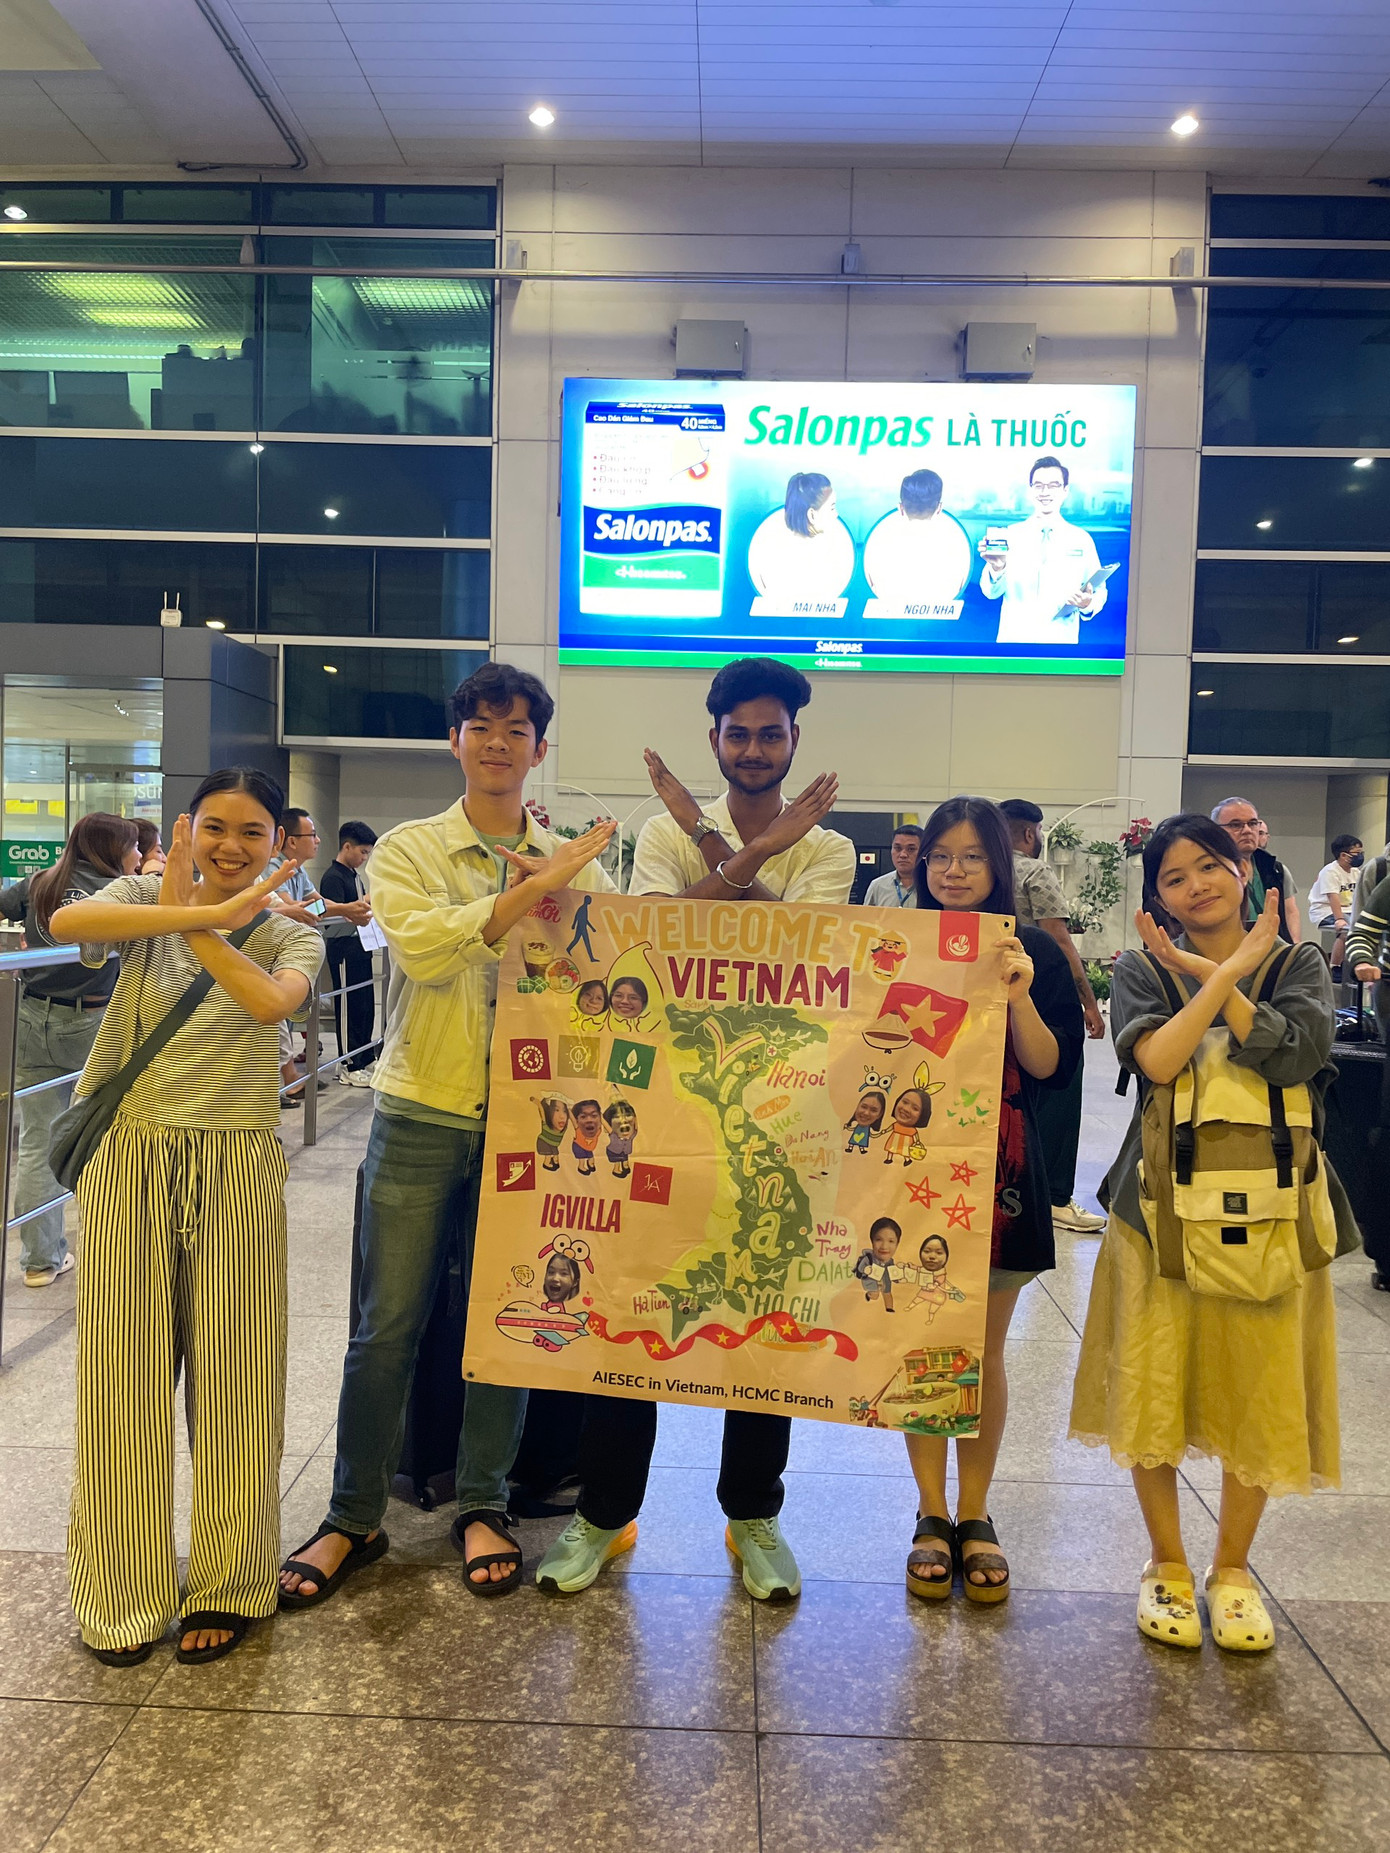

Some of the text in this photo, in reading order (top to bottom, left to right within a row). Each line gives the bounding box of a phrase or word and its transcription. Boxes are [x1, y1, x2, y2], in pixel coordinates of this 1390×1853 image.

[681, 417, 698, 430] 40
[743, 405, 1087, 455] Salonpas LÀ THUỐC
[8, 844, 50, 861] Grab
[602, 903, 842, 966] WELCOME
[666, 955, 850, 1009] VIETNAM
[766, 1060, 826, 1089] Hanoi
[769, 1111, 803, 1134] Hue
[540, 1193, 621, 1233] IGVILLA
[816, 1220, 848, 1237] Nha
[789, 1295, 821, 1322] CHI
[592, 1370, 834, 1409] AIESEC in Vietnam, HCMC Branch
